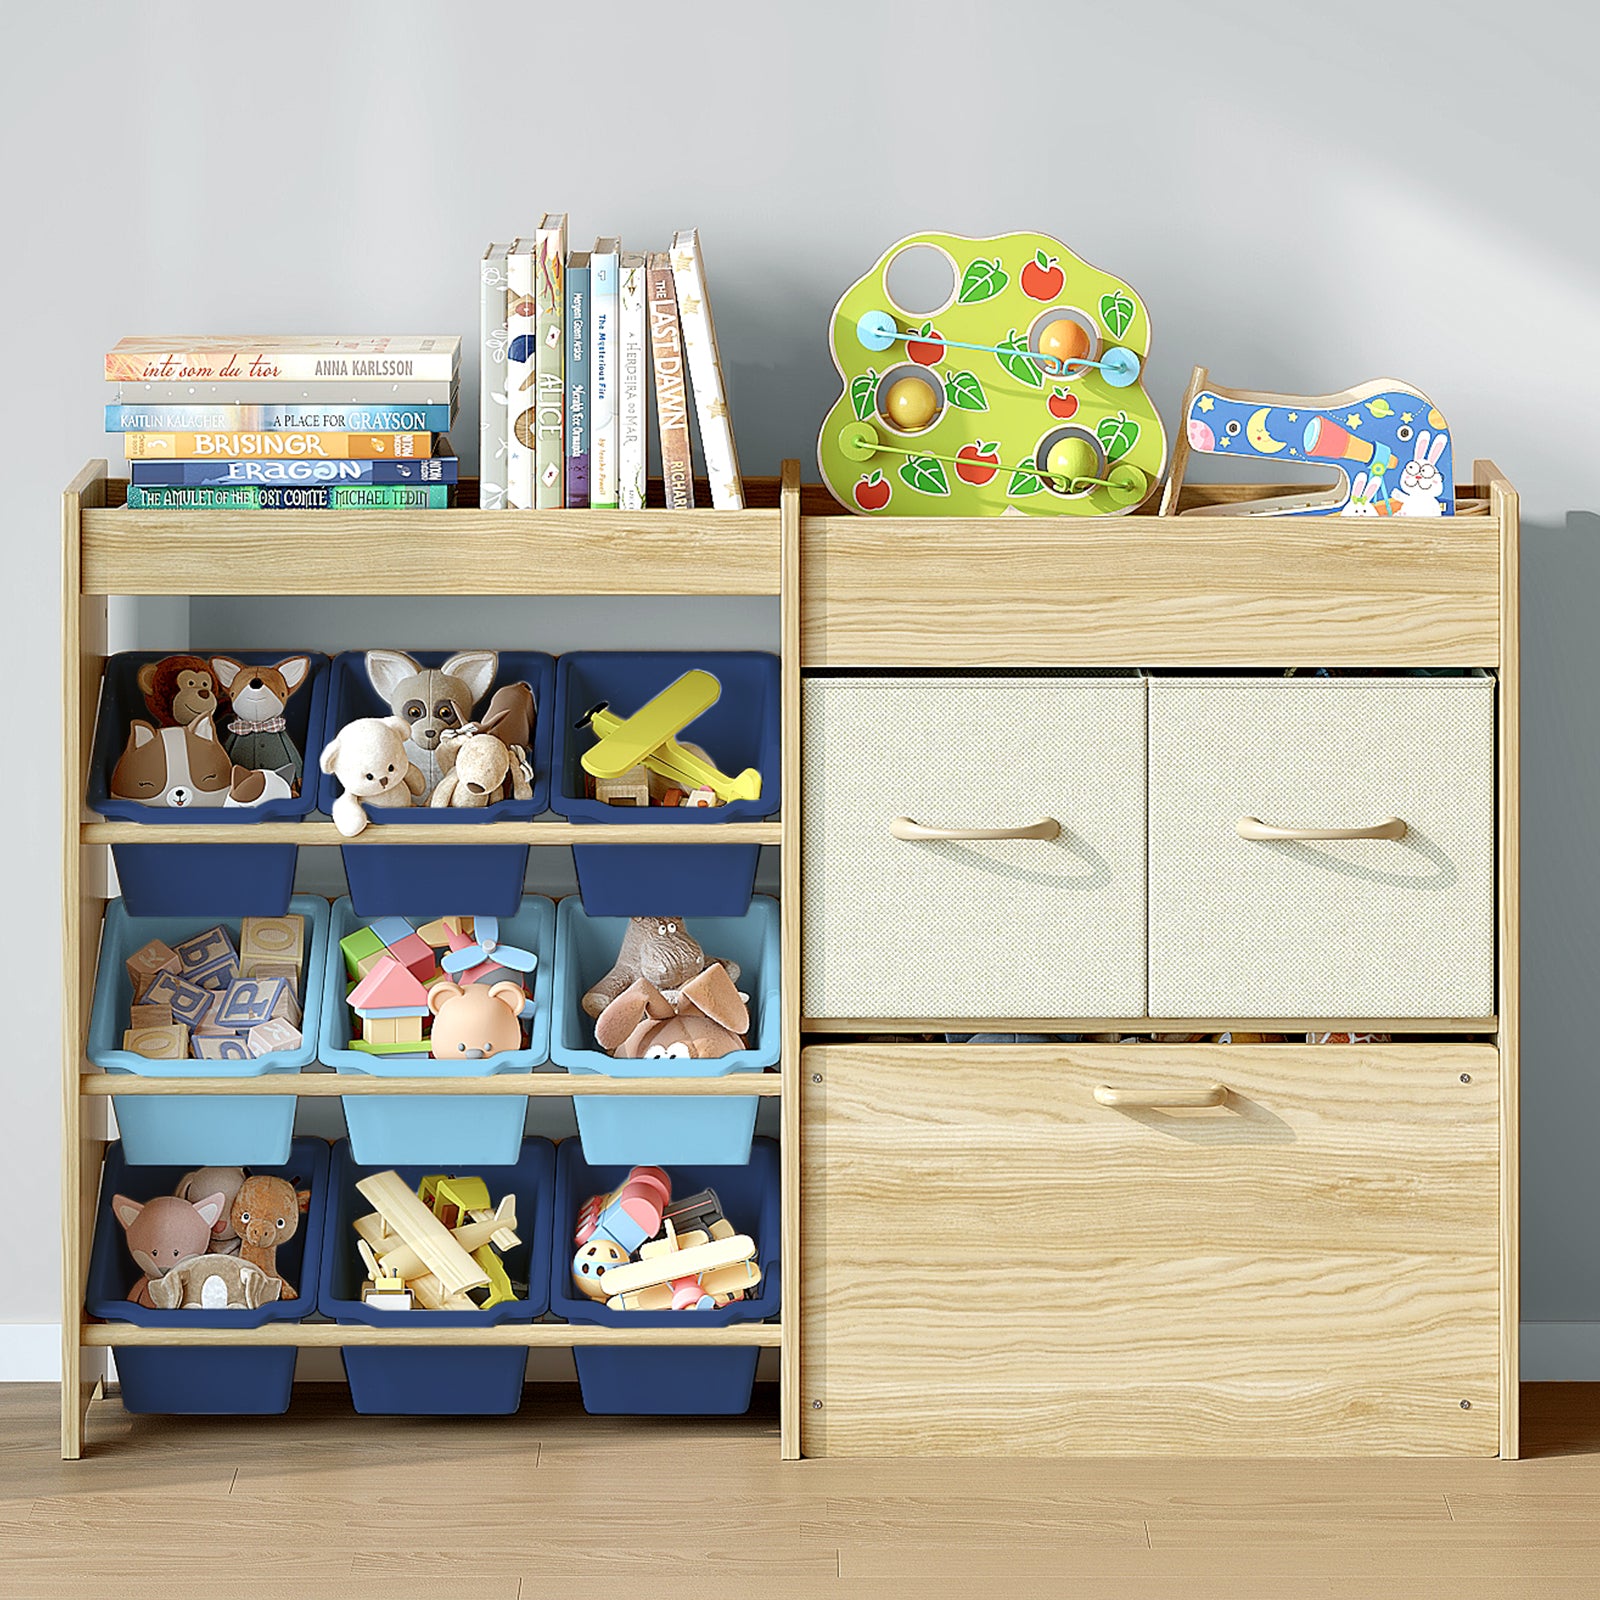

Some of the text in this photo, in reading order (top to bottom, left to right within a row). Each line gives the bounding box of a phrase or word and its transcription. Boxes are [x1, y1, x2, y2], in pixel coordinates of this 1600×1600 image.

[143, 354, 282, 377] inte som du tror
[597, 313, 607, 400] The Mysterious Fire
[651, 279, 686, 430] THE LAST DAWN
[315, 360, 413, 376] ANNA KARLSSON
[625, 342, 642, 400] HERDEIRA
[538, 373, 563, 441] ALICE
[120, 415, 226, 428] KAITLIN KALAGHER
[273, 412, 426, 430] A PLACE FOR GRAYSON
[622, 415, 639, 447] MAR
[193, 434, 329, 457] BRISINGR
[140, 489, 161, 506] THE
[163, 489, 214, 509] AMULET
[215, 491, 230, 505] OF
[335, 489, 390, 508] MICHAEL
[251, 920, 296, 950] O
[224, 983, 269, 1018] P
